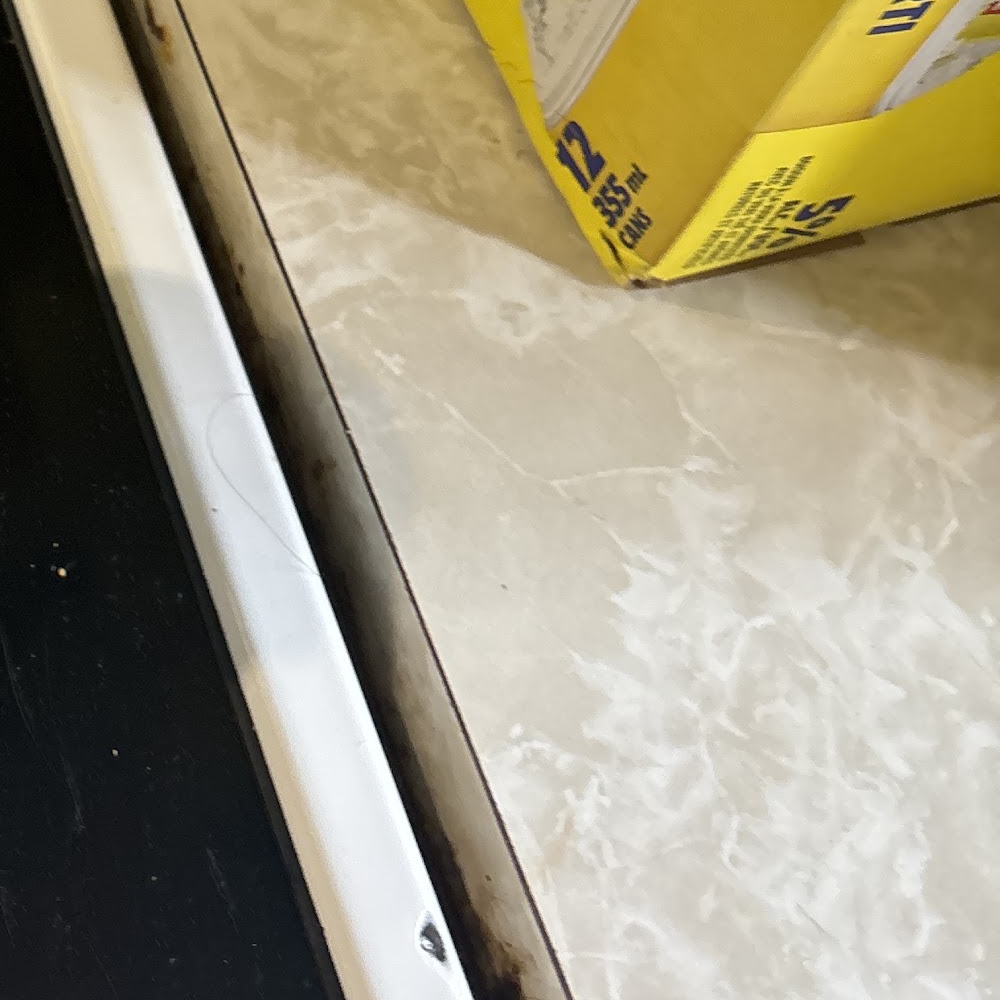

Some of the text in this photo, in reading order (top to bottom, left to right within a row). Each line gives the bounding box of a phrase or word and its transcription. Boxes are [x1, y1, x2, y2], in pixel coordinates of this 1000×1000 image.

[556, 121, 606, 193] 12
[592, 172, 632, 228] 355
[618, 206, 654, 250] CANS
